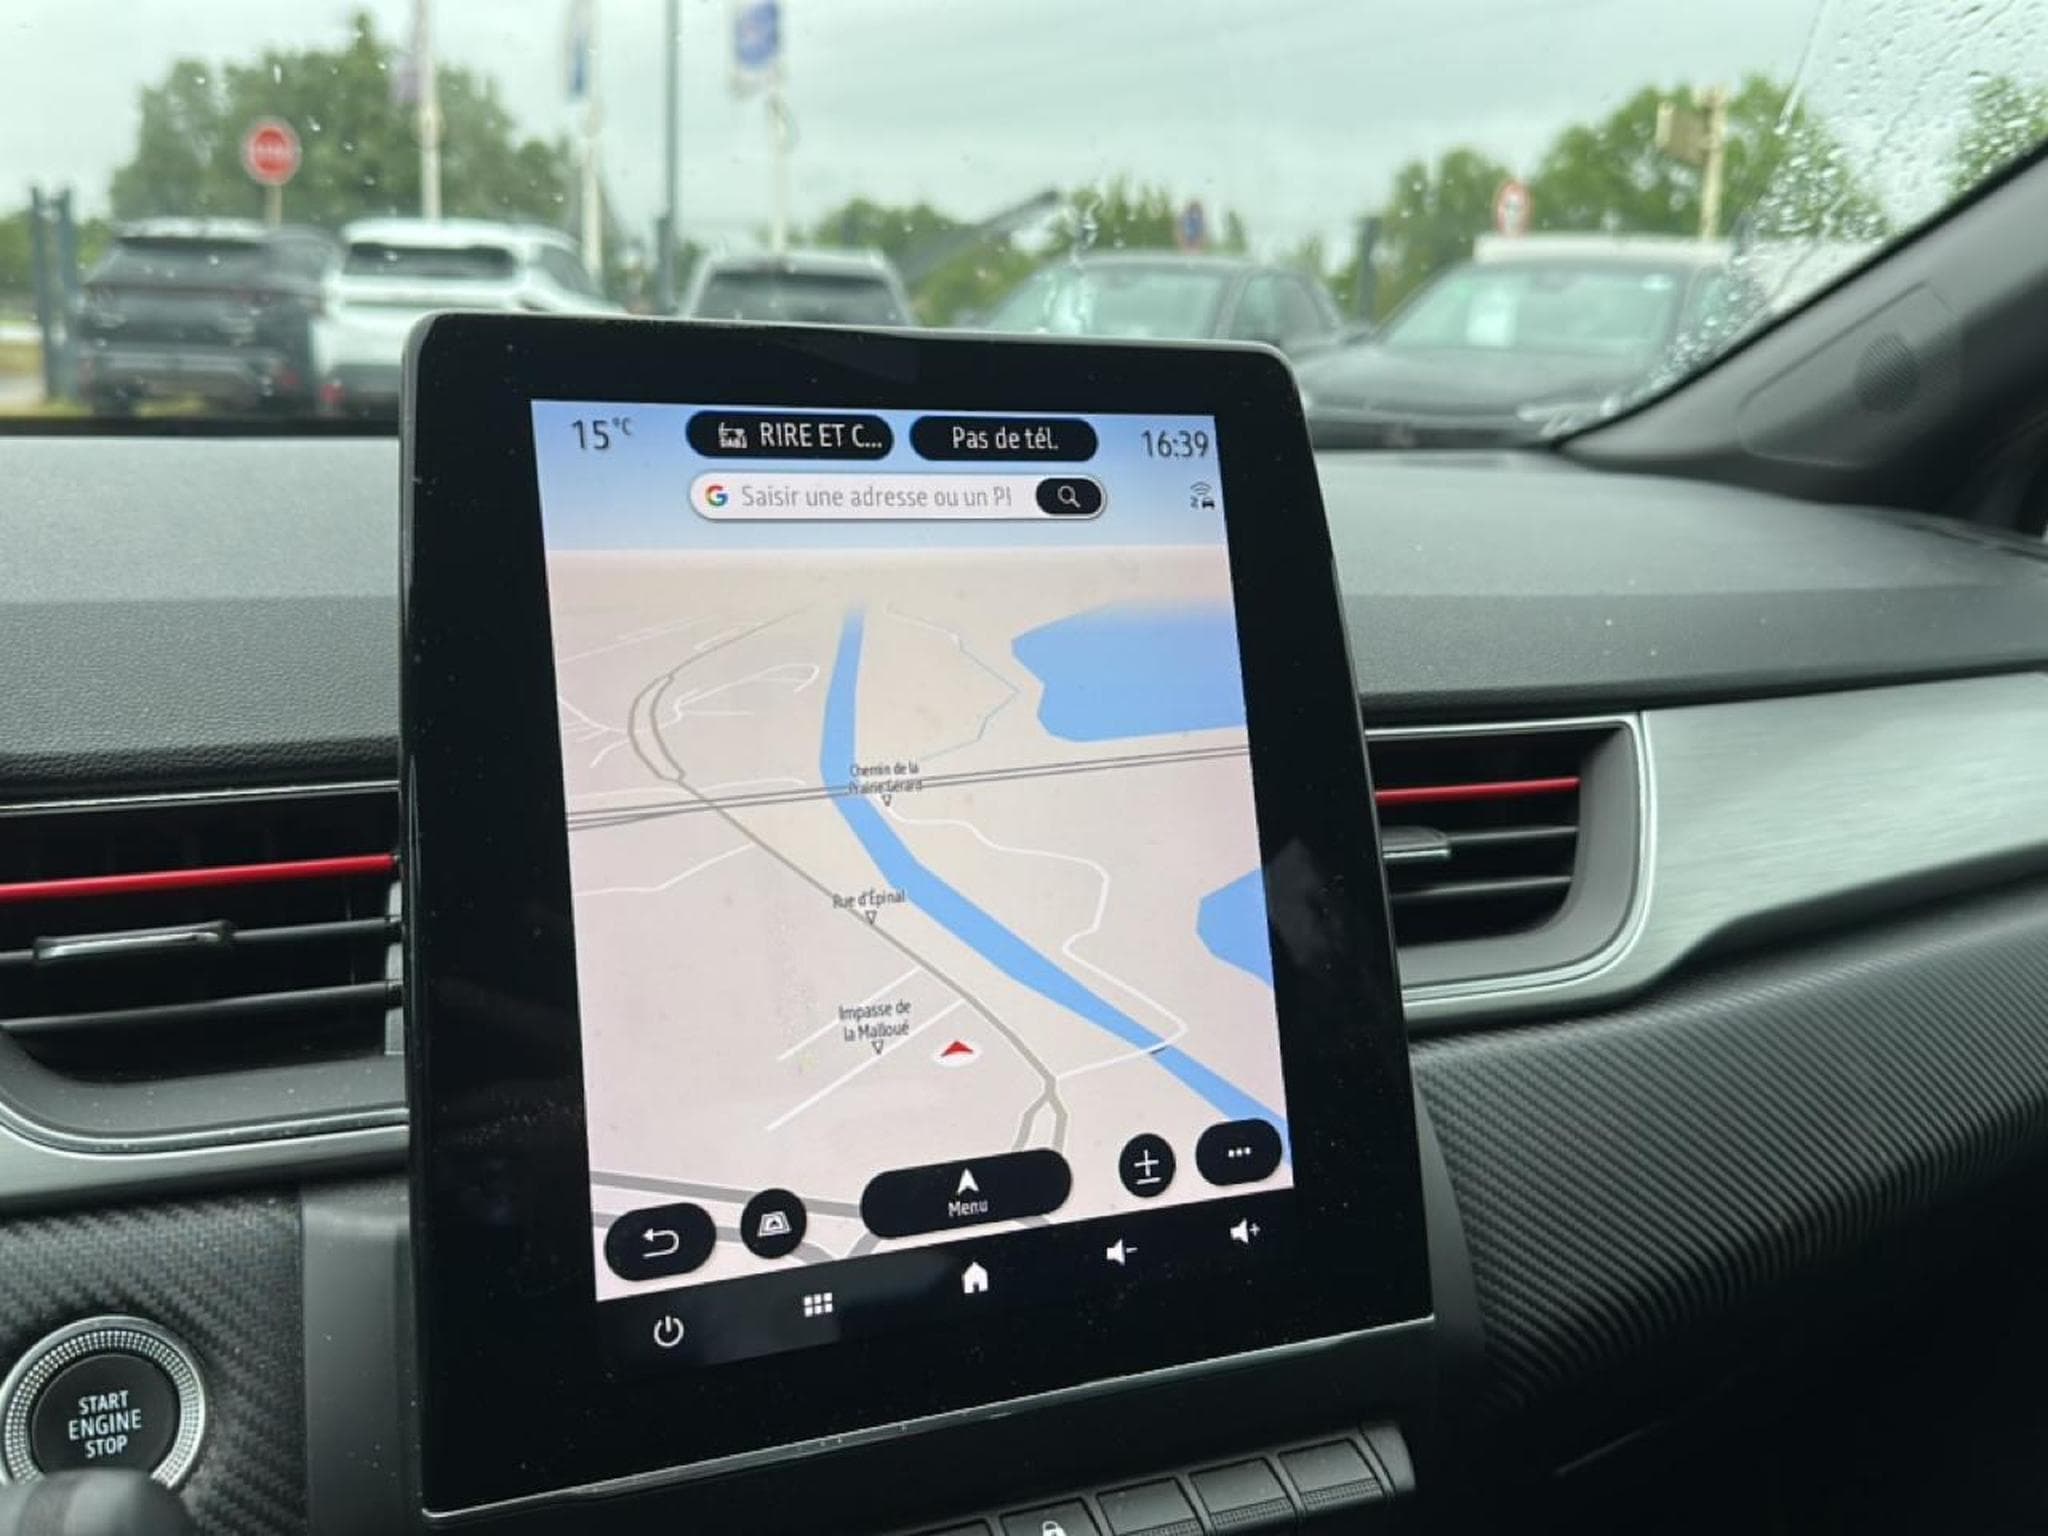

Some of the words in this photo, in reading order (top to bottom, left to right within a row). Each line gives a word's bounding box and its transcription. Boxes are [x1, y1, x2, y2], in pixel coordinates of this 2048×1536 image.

[760, 422, 811, 447] RIRE
[819, 423, 845, 447] ET
[952, 427, 988, 449] Pas
[995, 428, 1020, 449] de
[1025, 427, 1059, 450] tél.
[1141, 430, 1209, 457] 16:39
[741, 485, 797, 507] Saisir
[805, 490, 842, 508] une
[850, 488, 927, 508] adresse
[934, 490, 958, 507] ou
[964, 491, 987, 507] un
[850, 763, 891, 776] Chemin
[894, 762, 907, 775] de
[908, 759, 919, 773] la
[833, 894, 854, 909] Rue
[838, 1003, 893, 1022] Impasse
[895, 1000, 911, 1014] de
[844, 1026, 856, 1042] la
[857, 1019, 909, 1039] Malloué
[948, 1199, 988, 1218] Menu
[78, 1390, 129, 1415] START
[68, 1408, 142, 1441] ENGINE
[85, 1435, 128, 1459] STOP
